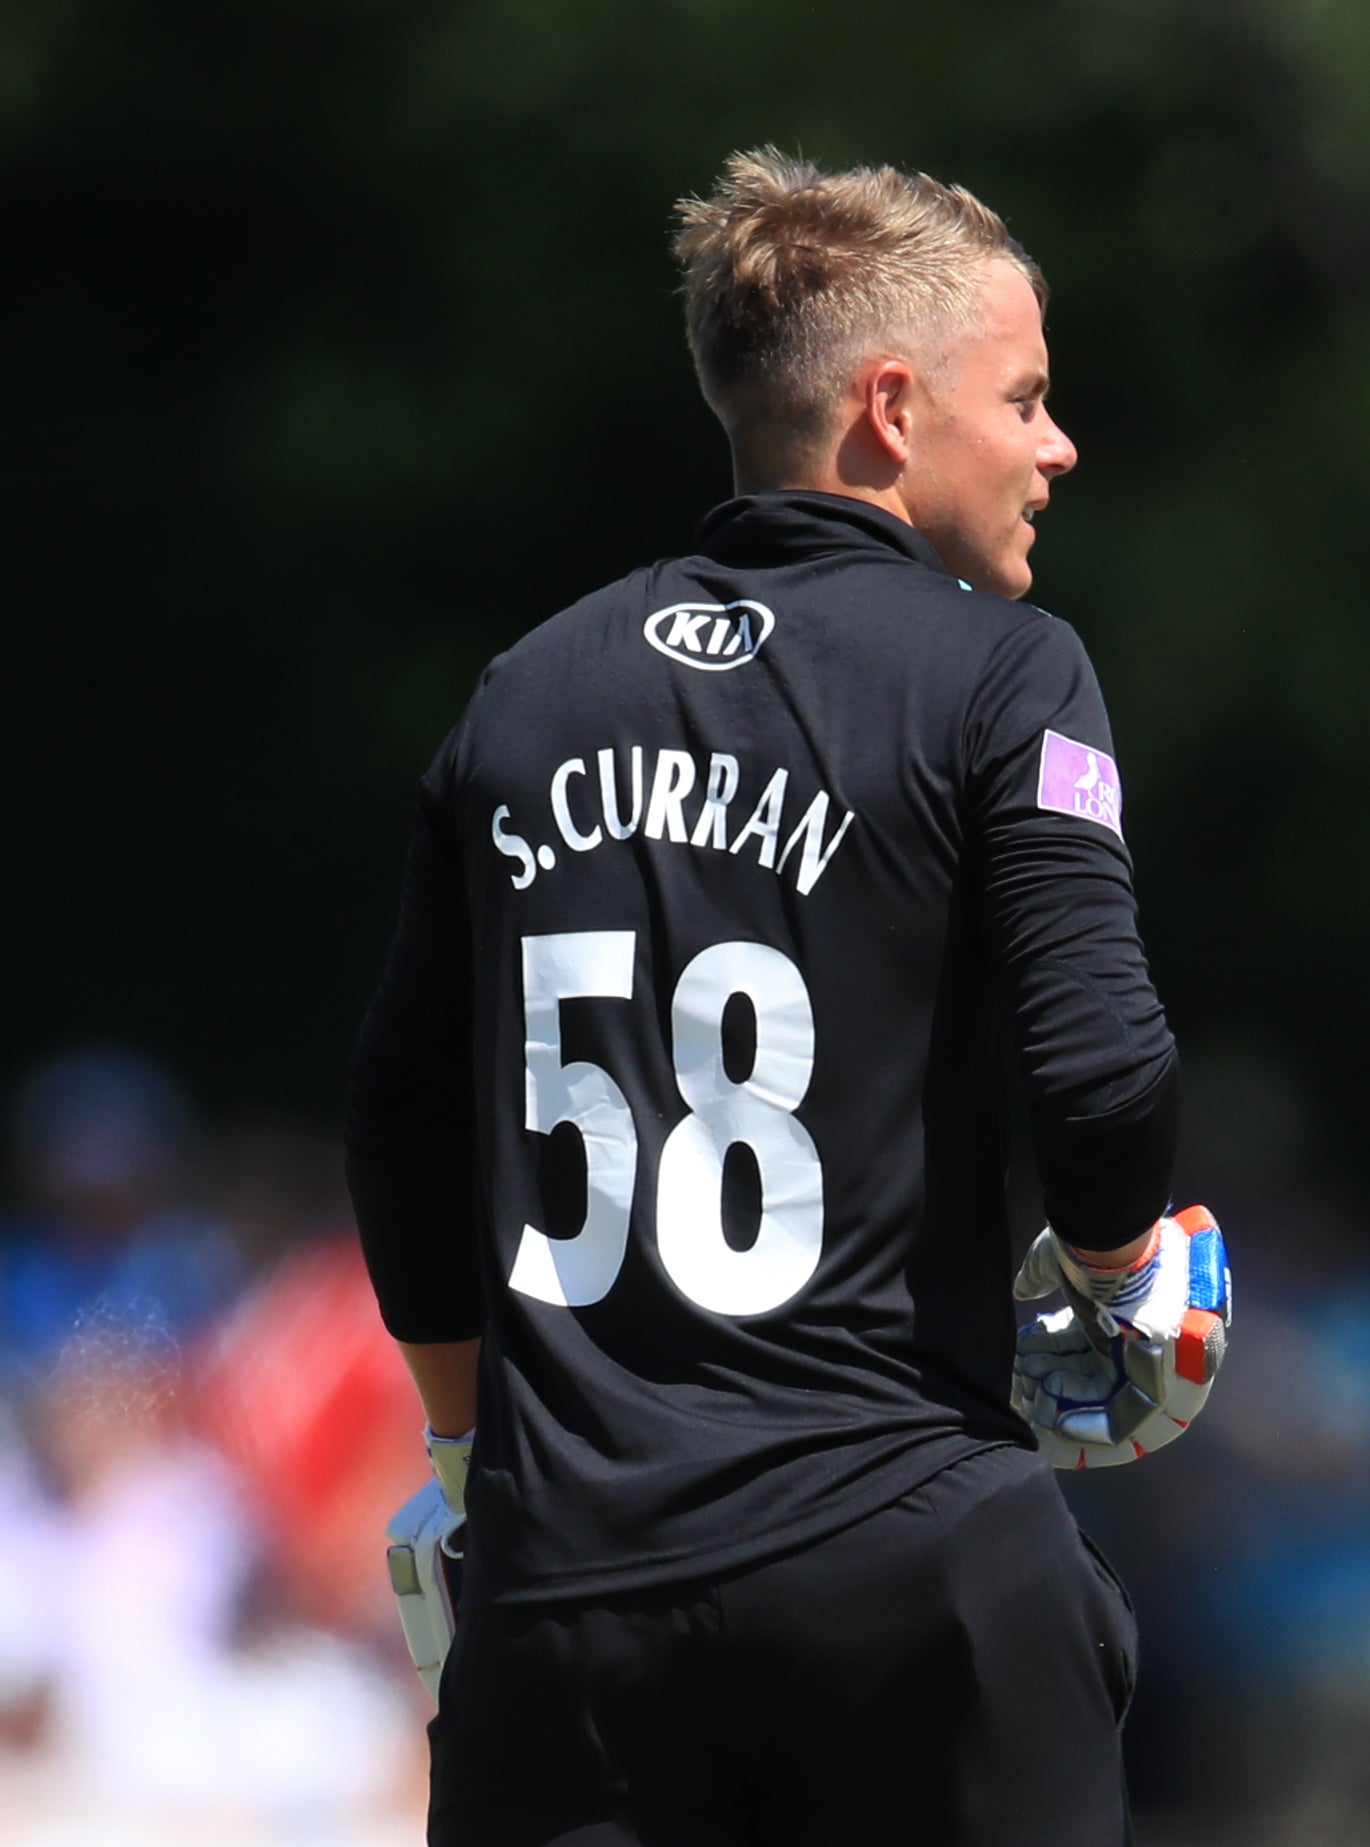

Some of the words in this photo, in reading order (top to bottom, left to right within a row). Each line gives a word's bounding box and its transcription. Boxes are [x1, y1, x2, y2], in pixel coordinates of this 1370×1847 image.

[665, 611, 753, 656] KIA
[492, 745, 855, 896] S.CURRAN
[507, 930, 825, 1317] 58
